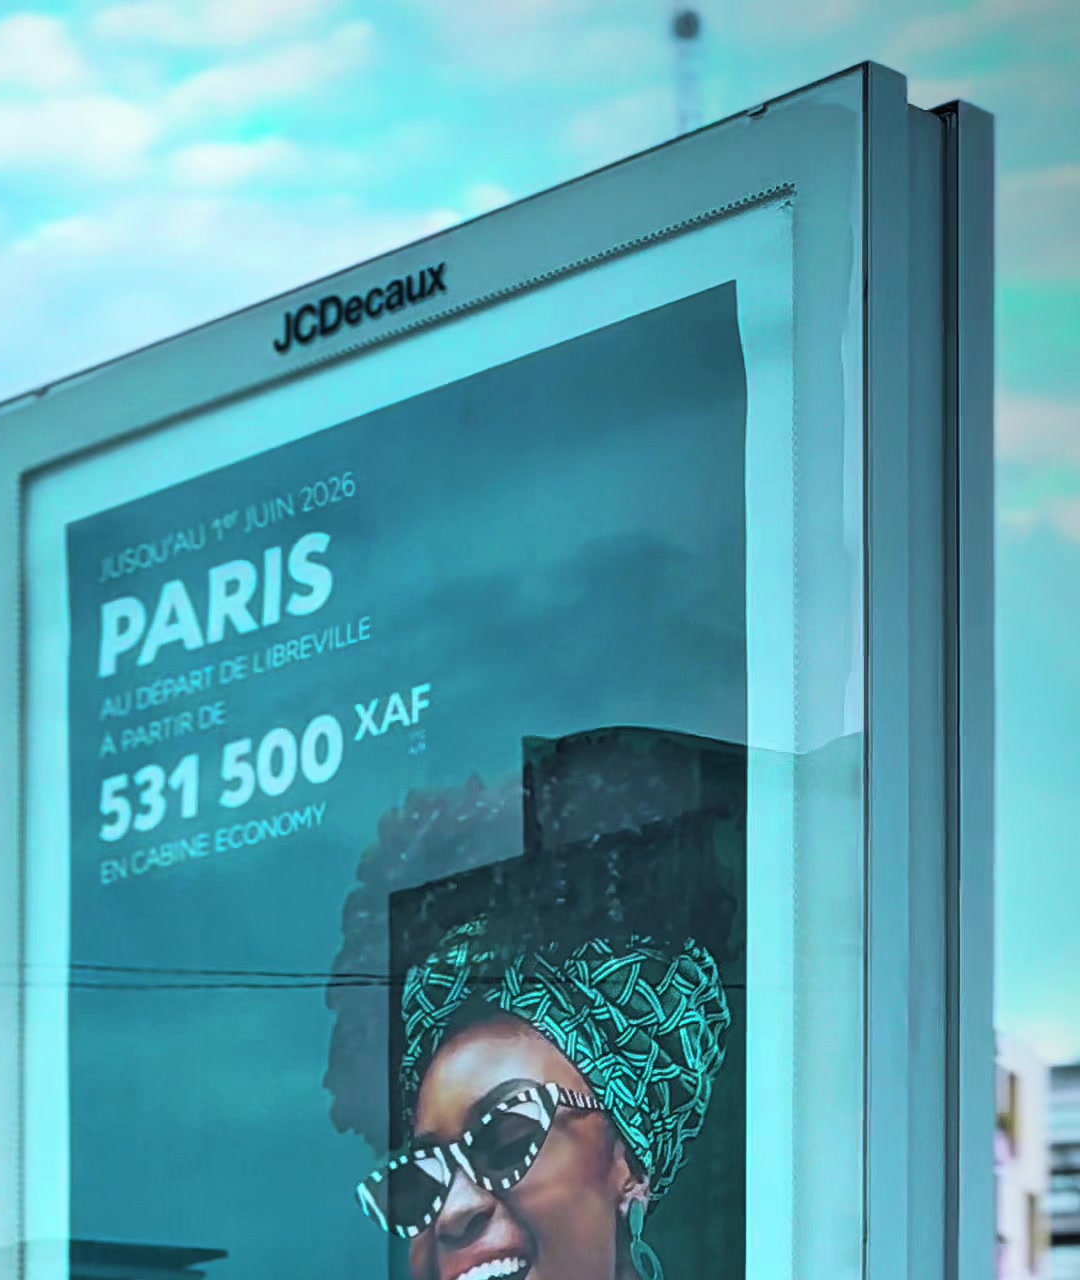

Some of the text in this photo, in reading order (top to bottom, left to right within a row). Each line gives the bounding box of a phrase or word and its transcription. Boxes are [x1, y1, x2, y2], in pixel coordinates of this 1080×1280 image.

[273, 262, 446, 354] JCDecaux
[98, 526, 205, 582] JUSQU'AU
[244, 497, 296, 532] JUIN
[301, 471, 356, 513] 2026
[98, 532, 333, 678] PARIS
[99, 693, 131, 721] AU
[219, 656, 248, 684] DE
[253, 616, 371, 674] LIBREVILLE
[99, 683, 431, 841] 531 500 XAF
[122, 710, 193, 749] PARTIR
[198, 702, 226, 729] DE
[100, 803, 325, 884] EN CABINE ECONOMY
